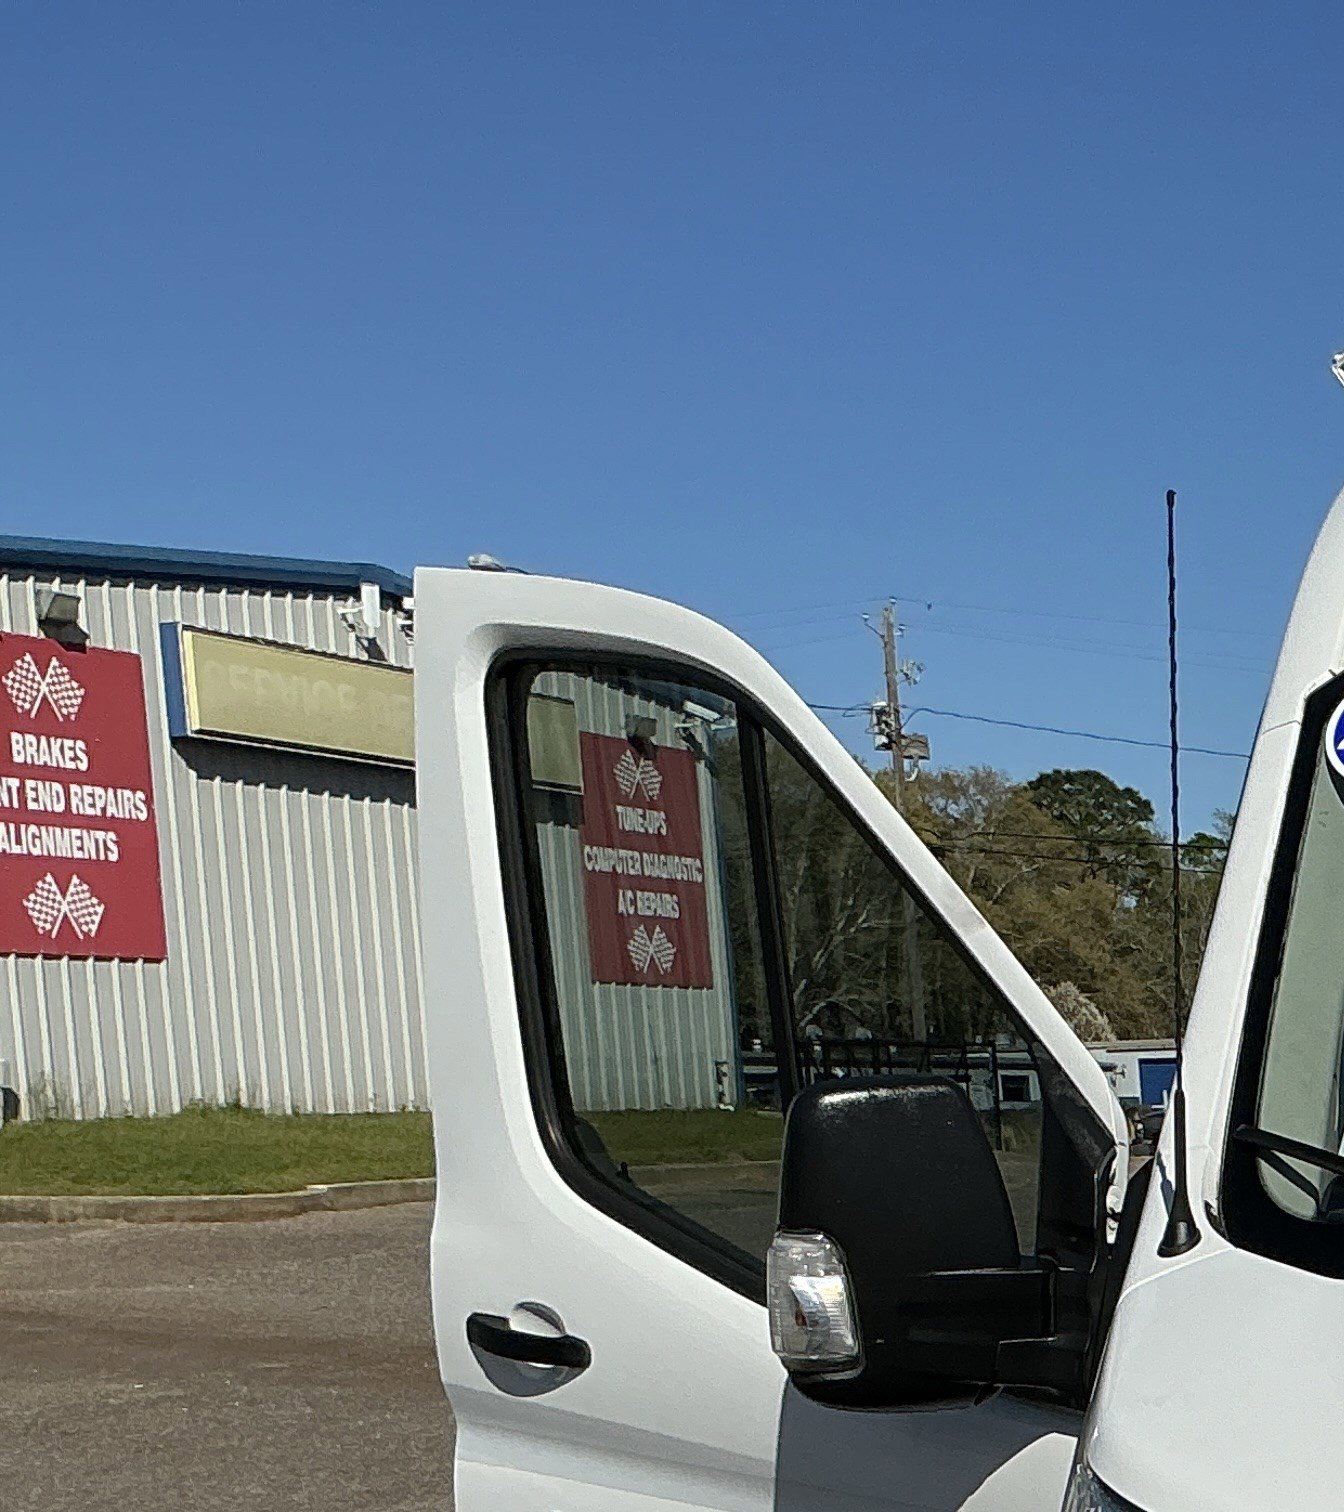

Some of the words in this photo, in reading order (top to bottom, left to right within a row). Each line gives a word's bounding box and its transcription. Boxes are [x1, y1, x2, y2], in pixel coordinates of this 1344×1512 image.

[10, 731, 89, 772] BRAKES
[24, 779, 66, 813] END
[69, 783, 148, 821] REPAIRS
[0, 821, 119, 862] ALIGNMENTS
[584, 845, 642, 876] COMPUTER
[642, 852, 702, 883] DIAGNOSTIC
[636, 889, 680, 920] REPAIRS
